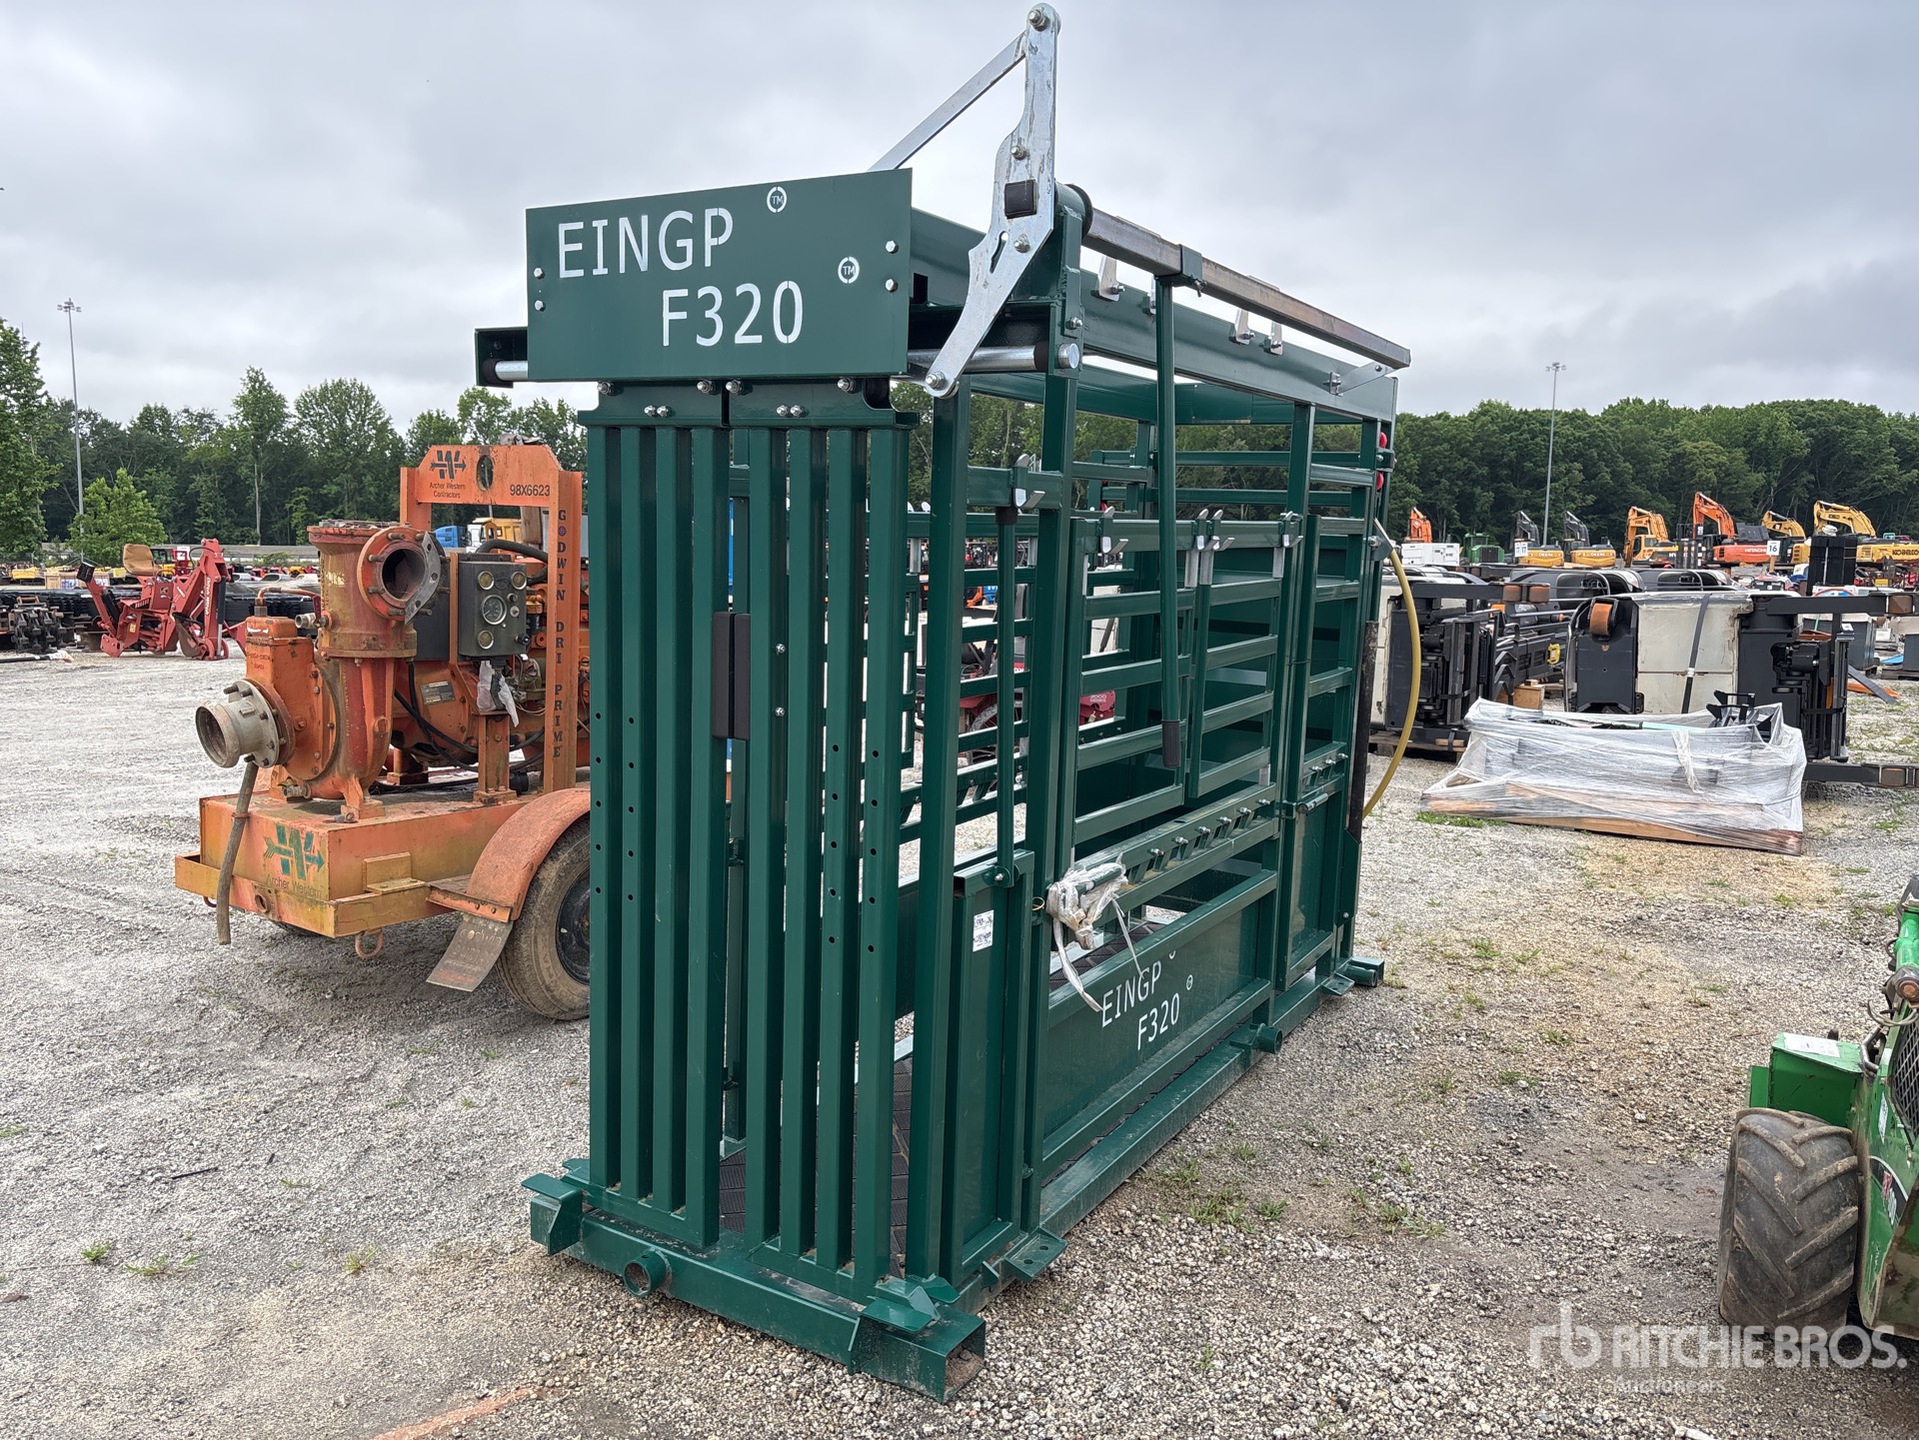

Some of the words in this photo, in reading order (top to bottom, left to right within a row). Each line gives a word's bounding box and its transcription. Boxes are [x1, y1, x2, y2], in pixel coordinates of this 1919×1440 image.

[558, 207, 734, 279] EINGP
[662, 280, 804, 347] F320
[429, 482, 446, 490] Archer
[446, 482, 466, 490] Western
[433, 490, 461, 499] Contractors
[509, 484, 551, 497] 98X6623
[1769, 545, 1778, 553] 16
[555, 621, 565, 664] DRI
[553, 684, 563, 758] PRIME
[1102, 960, 1162, 1028] EINGP
[1137, 992, 1180, 1051] F320
